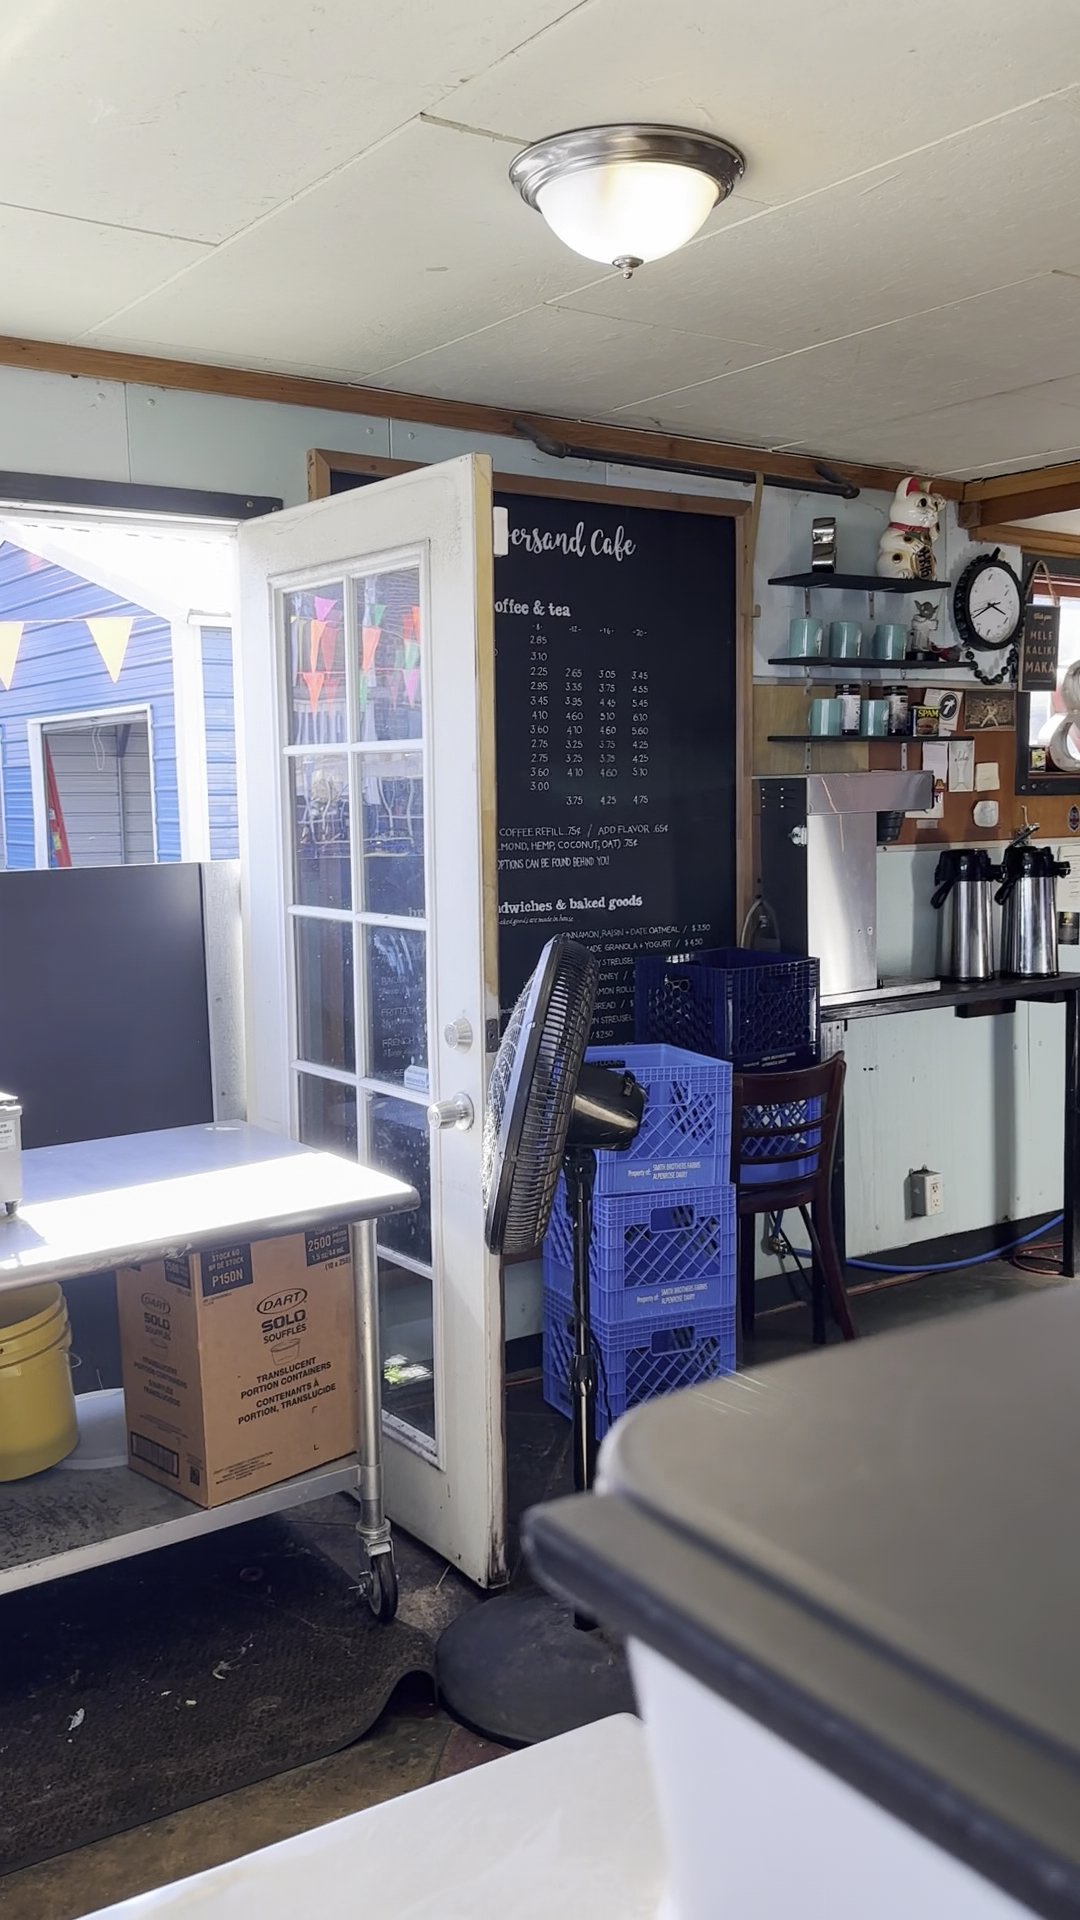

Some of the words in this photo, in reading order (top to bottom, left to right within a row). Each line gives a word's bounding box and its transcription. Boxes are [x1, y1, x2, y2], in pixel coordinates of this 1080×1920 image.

[509, 521, 587, 557] ersand
[590, 525, 637, 561] Cafe
[495, 598, 529, 615] offee
[533, 599, 546, 616] &
[548, 602, 572, 617] tea
[530, 651, 548, 662] 3.10
[530, 666, 549, 677] 2.25
[598, 669, 617, 679] 3.05
[631, 670, 649, 680] 3.45
[1024, 660, 1057, 673] MAKA
[530, 681, 549, 691] 2.95
[565, 681, 583, 691] 3.35
[598, 683, 616, 693] 3.75
[530, 696, 549, 706] 3.45
[564, 696, 583, 706] 3.95
[631, 699, 649, 708] 5.45
[917, 709, 939, 718] SPAM
[530, 724, 550, 734] 3.60
[631, 726, 649, 735] 5.60
[531, 738, 549, 748] 2.75
[565, 739, 583, 749] 3.25
[632, 740, 649, 749] 4.25
[531, 753, 549, 763] 2.75
[565, 753, 583, 763] 3.25
[530, 767, 550, 777] 3.60
[632, 766, 649, 777] 5.10
[530, 781, 550, 791] 3.00
[566, 795, 583, 805] 3.75
[632, 795, 649, 805] 4.75
[499, 826, 534, 838] COFFEE
[535, 825, 564, 837] REFILL
[598, 825, 616, 836] ADD
[618, 824, 650, 835] FLAVOR
[498, 841, 530, 852] MOND,
[531, 841, 556, 852] HEMP,
[558, 839, 600, 851] COCONUT,
[525, 857, 540, 869] CAN
[540, 857, 550, 868] BE
[551, 856, 571, 867] FOUND
[572, 856, 594, 867] BEHIND
[596, 855, 611, 866] YOU
[555, 898, 567, 911] &
[569, 896, 606, 910] baked
[609, 894, 644, 911] goods
[561, 930, 600, 940] CNNAMON,
[602, 928, 624, 938] RAISIN
[630, 927, 648, 936] DATE
[649, 926, 681, 935] OATMEAL
[604, 943, 638, 952] GRANOLA
[644, 940, 672, 949] YOGURT
[599, 971, 619, 981] ONEY
[308, 1234, 331, 1253] 2500
[212, 1250, 231, 1262] STOCK
[216, 1260, 225, 1270] DE
[225, 1256, 244, 1267] STOCK
[212, 1267, 244, 1288] P150N
[263, 1291, 302, 1312] DART
[144, 1312, 170, 1331] SOLO
[261, 1309, 306, 1333] SOLO
[256, 1356, 317, 1383] TRANSLUCENT
[241, 1380, 279, 1400] PORTION
[281, 1361, 332, 1386] CONTAINERS
[256, 1382, 312, 1408] CONTENANTS
[238, 1405, 280, 1425] PORTION,
[281, 1383, 337, 1409] TRANSLUCIDE
